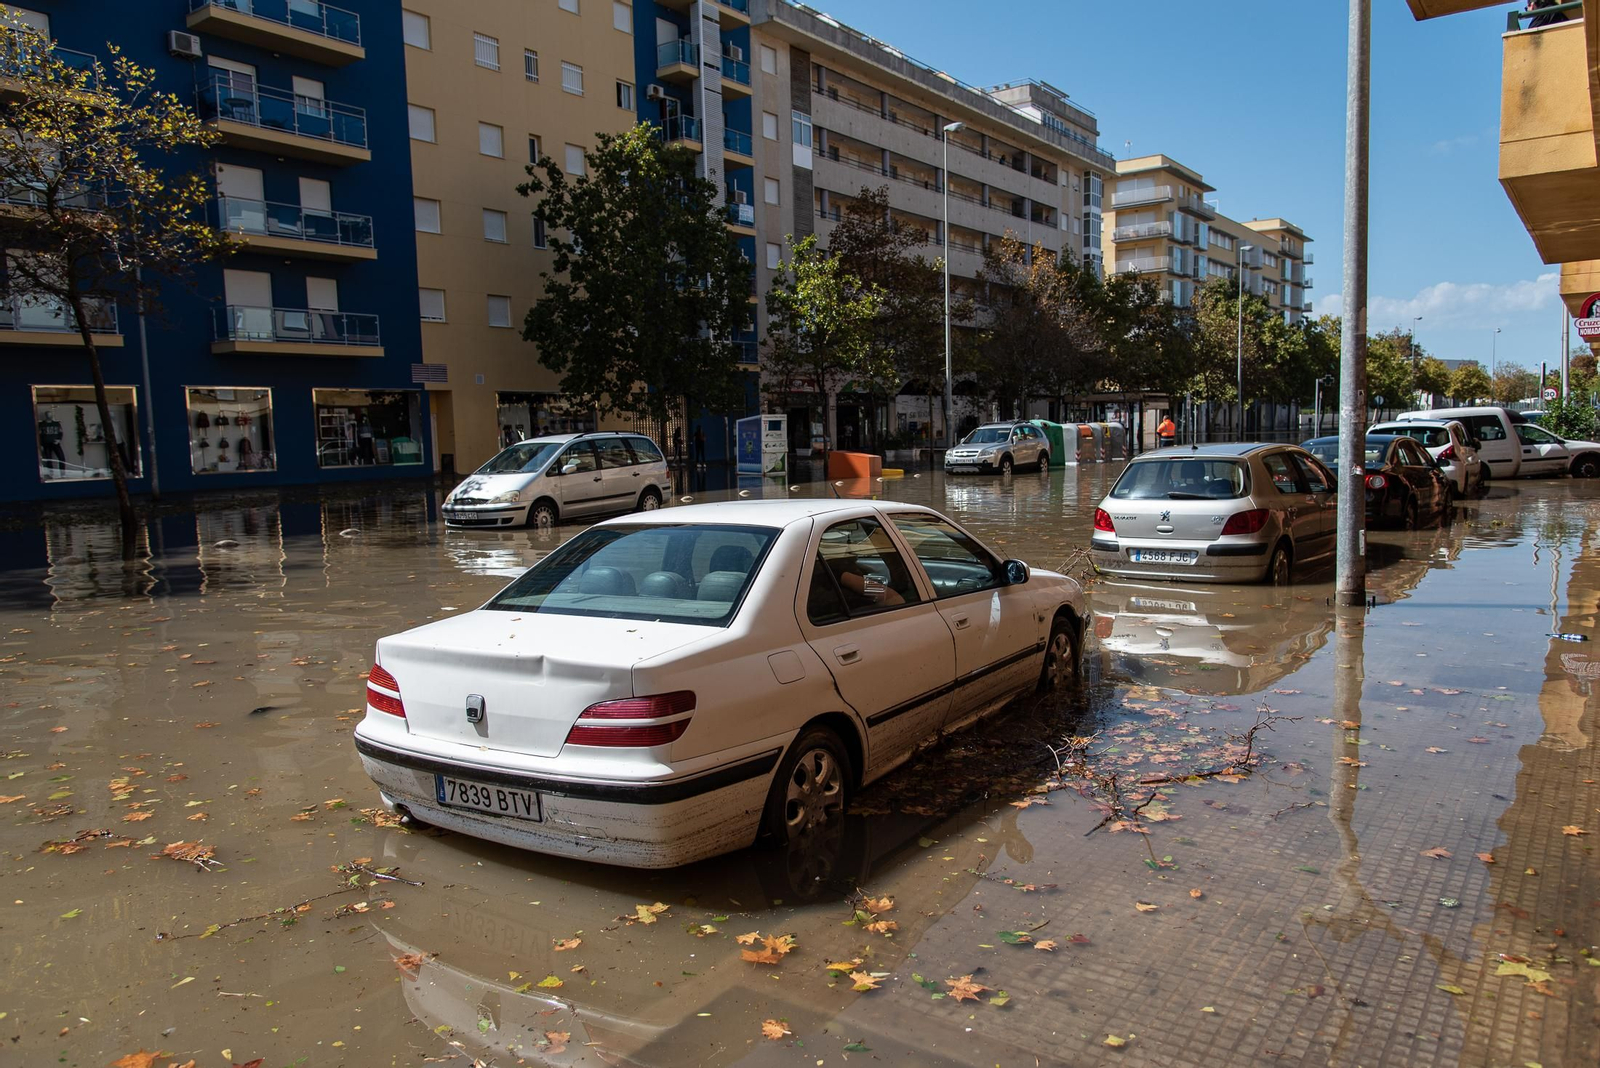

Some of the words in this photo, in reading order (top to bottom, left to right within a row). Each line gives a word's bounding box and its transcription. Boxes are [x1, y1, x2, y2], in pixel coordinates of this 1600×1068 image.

[1142, 551, 1166, 562] 4568
[1169, 552, 1189, 563] FJC
[448, 780, 492, 808] 7839
[497, 789, 532, 815] BTV
